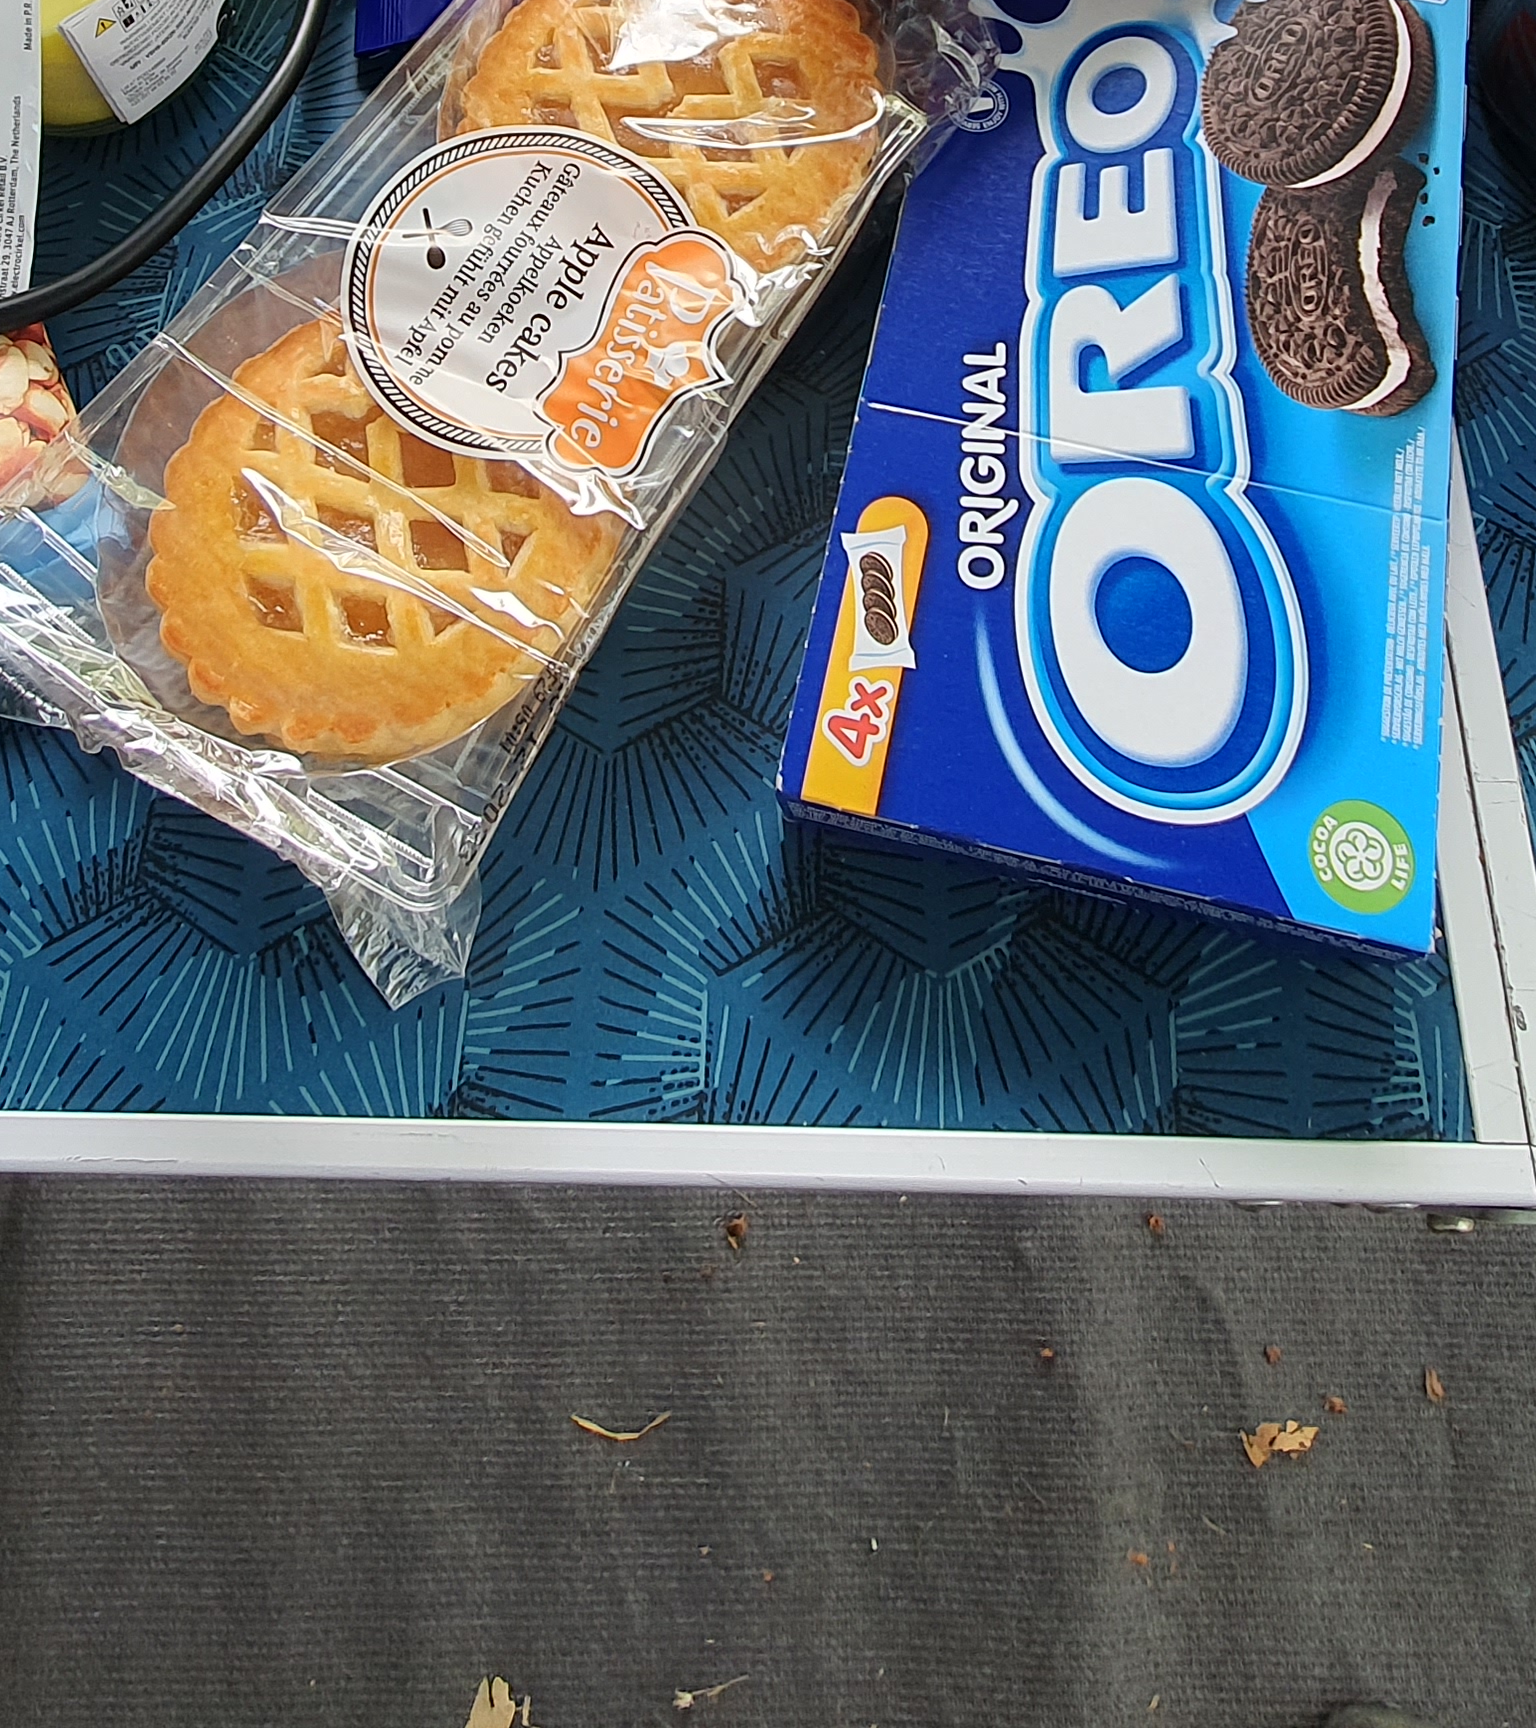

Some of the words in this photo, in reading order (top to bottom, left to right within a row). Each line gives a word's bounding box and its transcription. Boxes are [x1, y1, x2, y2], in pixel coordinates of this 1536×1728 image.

[24, 27, 33, 50] Made
[1254, 23, 1303, 100] OREO
[12, 96, 21, 146] Netherlands
[0, 155, 8, 170] B.V.
[8, 167, 19, 213] Rotterdam,
[10, 149, 19, 164] The
[6, 216, 15, 226] AJ
[500, 160, 555, 228] Kuchen
[525, 162, 582, 232] Gâteaux
[2, 253, 12, 266] 29,
[3, 229, 13, 250] 3047
[453, 220, 508, 288] gefühlt
[476, 230, 530, 302] fourrées
[545, 221, 616, 310] Apple
[1298, 223, 1325, 313] OREO
[428, 284, 459, 330] mit
[458, 301, 482, 329] au
[478, 233, 565, 345] Appelkoeken
[393, 316, 437, 367] Apfel
[485, 312, 552, 394] cakes
[570, 260, 712, 449] Patisserie
[1048, 32, 1250, 770] OREO
[956, 340, 1012, 592] ORIGINAL
[826, 677, 898, 770] 4x
[1312, 814, 1340, 883] COCOA
[1390, 843, 1411, 892] LIFE
